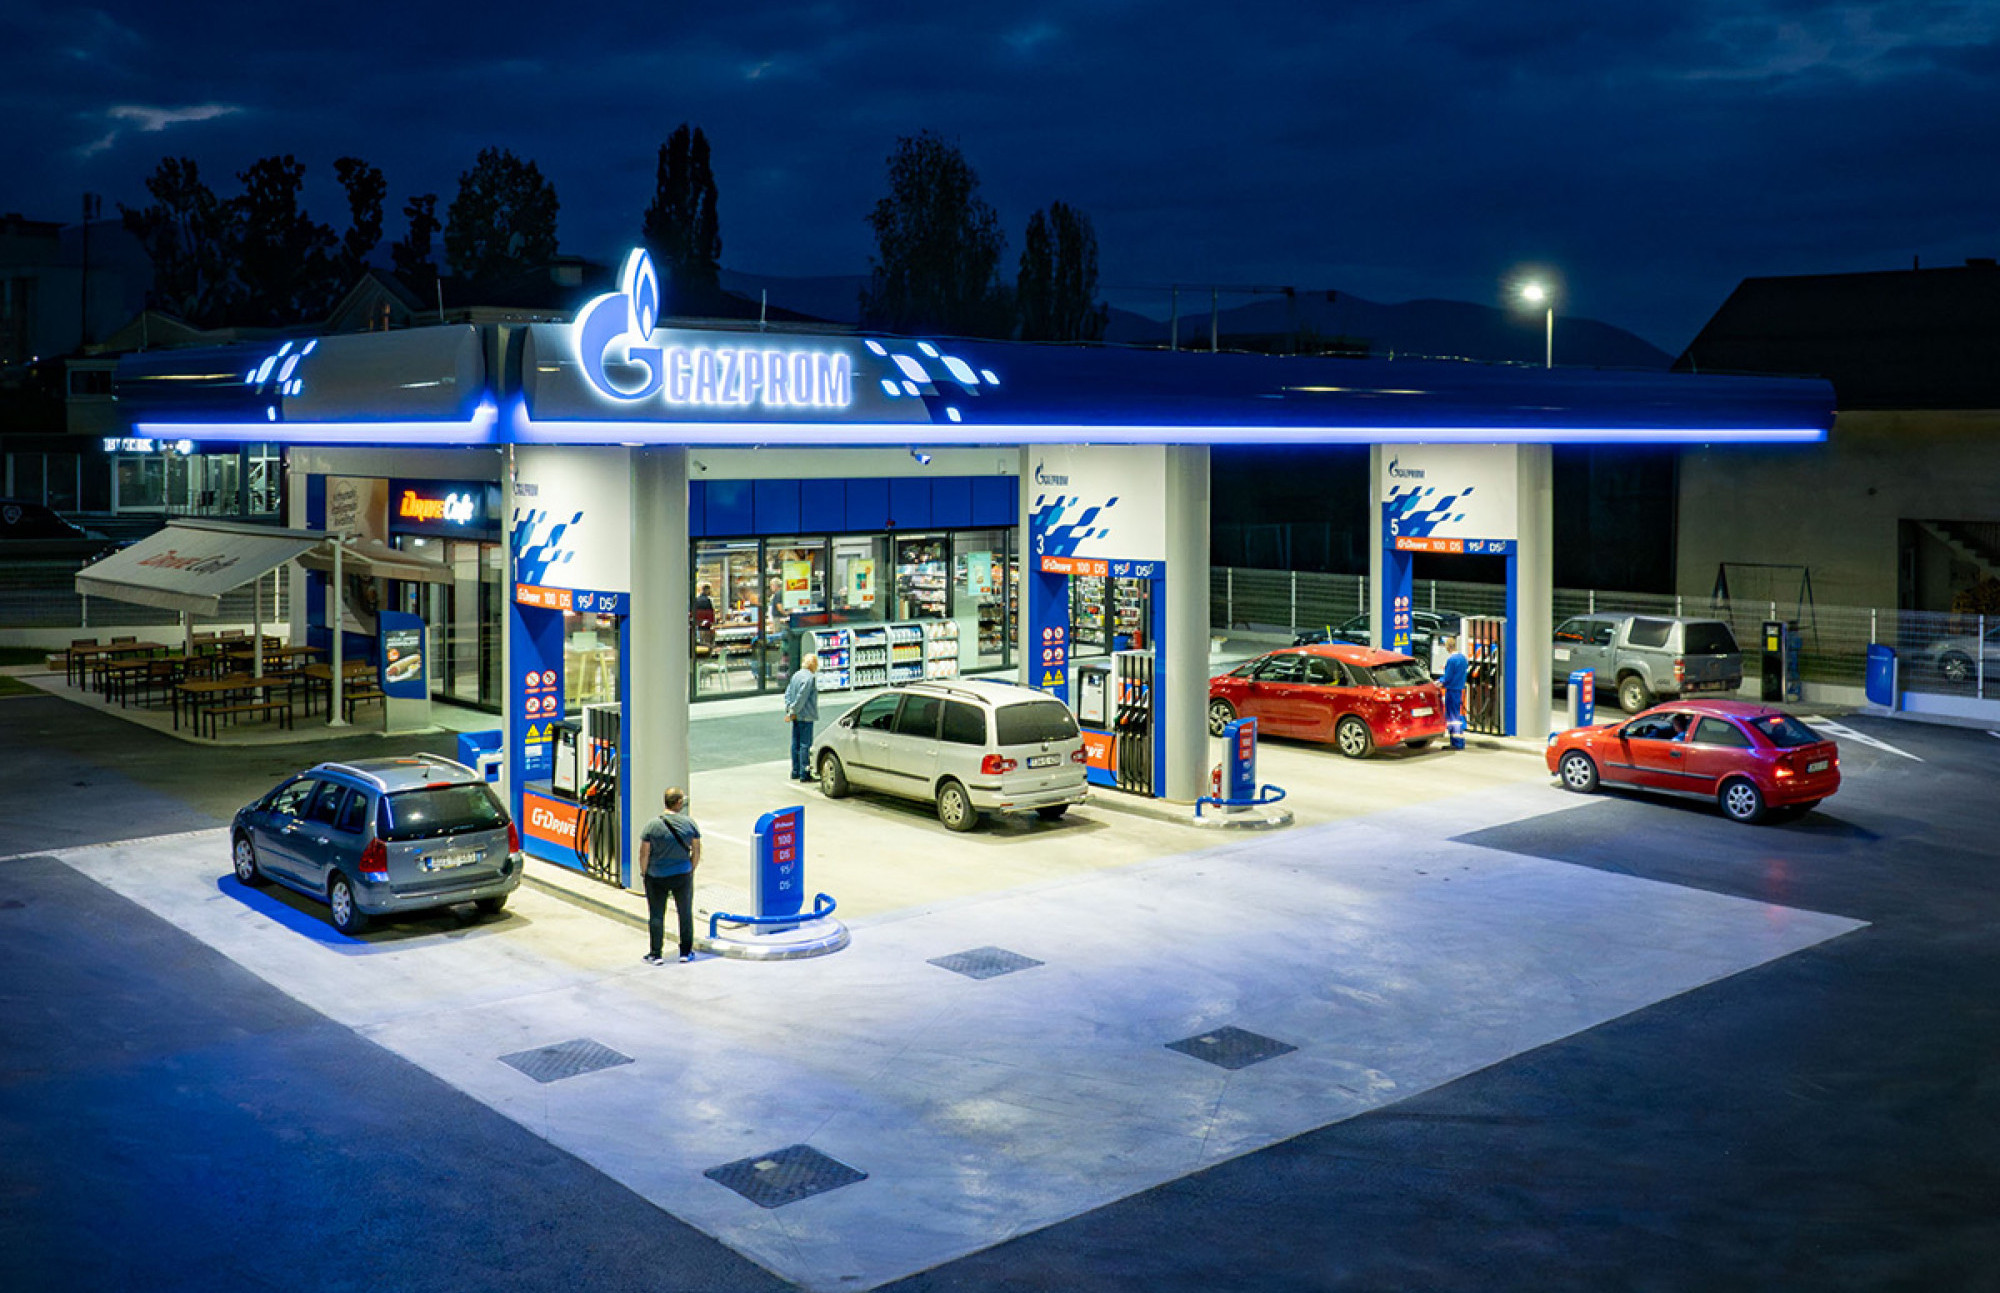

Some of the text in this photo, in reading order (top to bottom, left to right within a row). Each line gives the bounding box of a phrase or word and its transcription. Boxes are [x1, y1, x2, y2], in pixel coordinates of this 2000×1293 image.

[667, 347, 851, 407] GAZPROM
[1391, 518, 1400, 536] 5
[1035, 533, 1045, 555] 3
[1432, 540, 1447, 551] 100
[1468, 541, 1480, 552] 95
[1076, 562, 1090, 574] 100
[1113, 563, 1126, 575] 95
[544, 591, 556, 605] 100
[577, 594, 590, 610] 95
